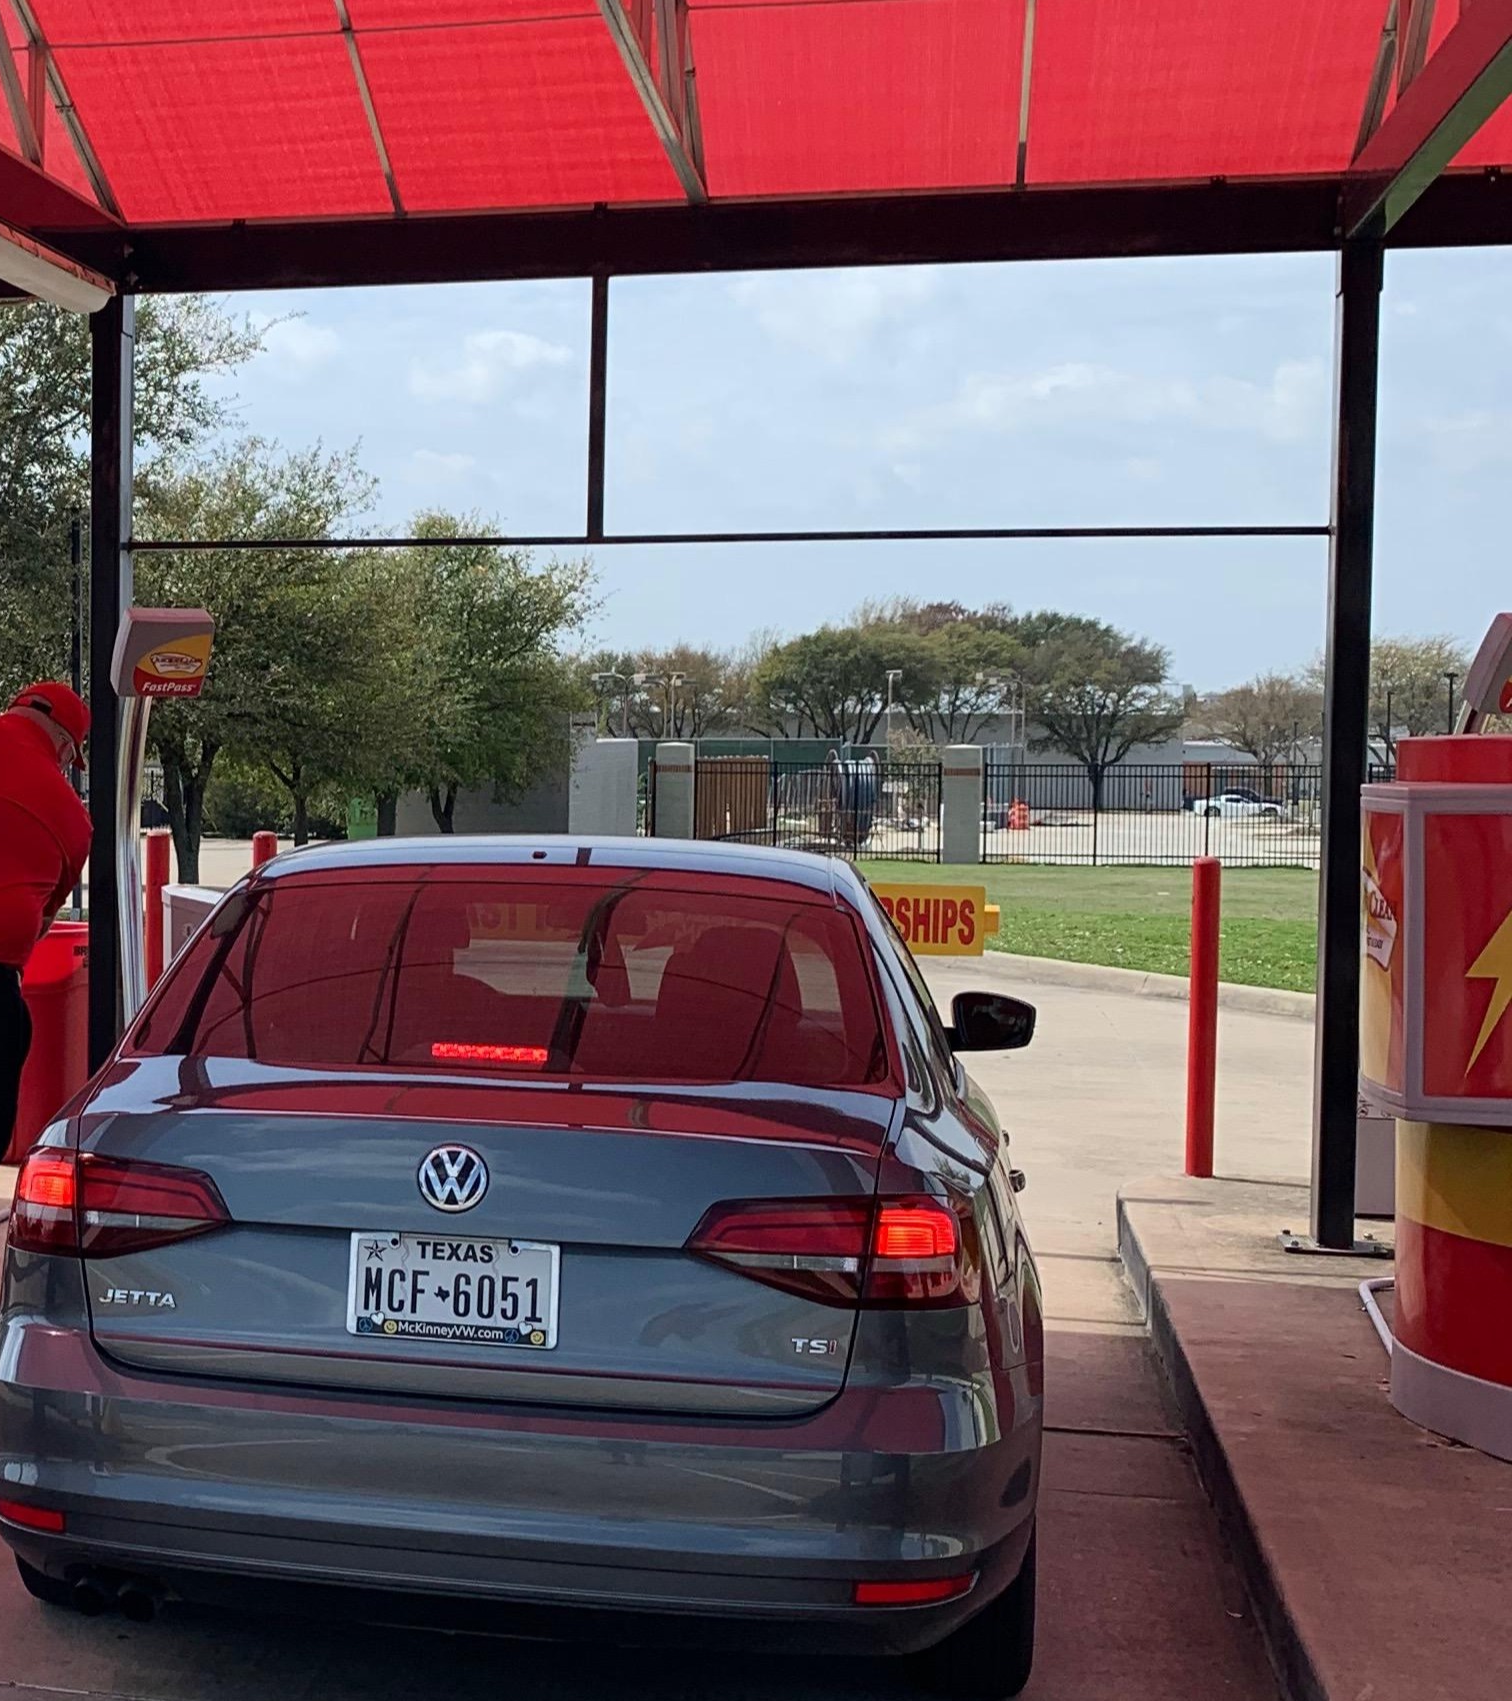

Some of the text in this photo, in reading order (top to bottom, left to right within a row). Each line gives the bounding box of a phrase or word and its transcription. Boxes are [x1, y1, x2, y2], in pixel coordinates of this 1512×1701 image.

[142, 682, 193, 692] FastPass
[416, 1241, 494, 1263] TEXAS
[98, 1289, 176, 1308] JETTA
[397, 1321, 504, 1341] McKinneyVW.com
